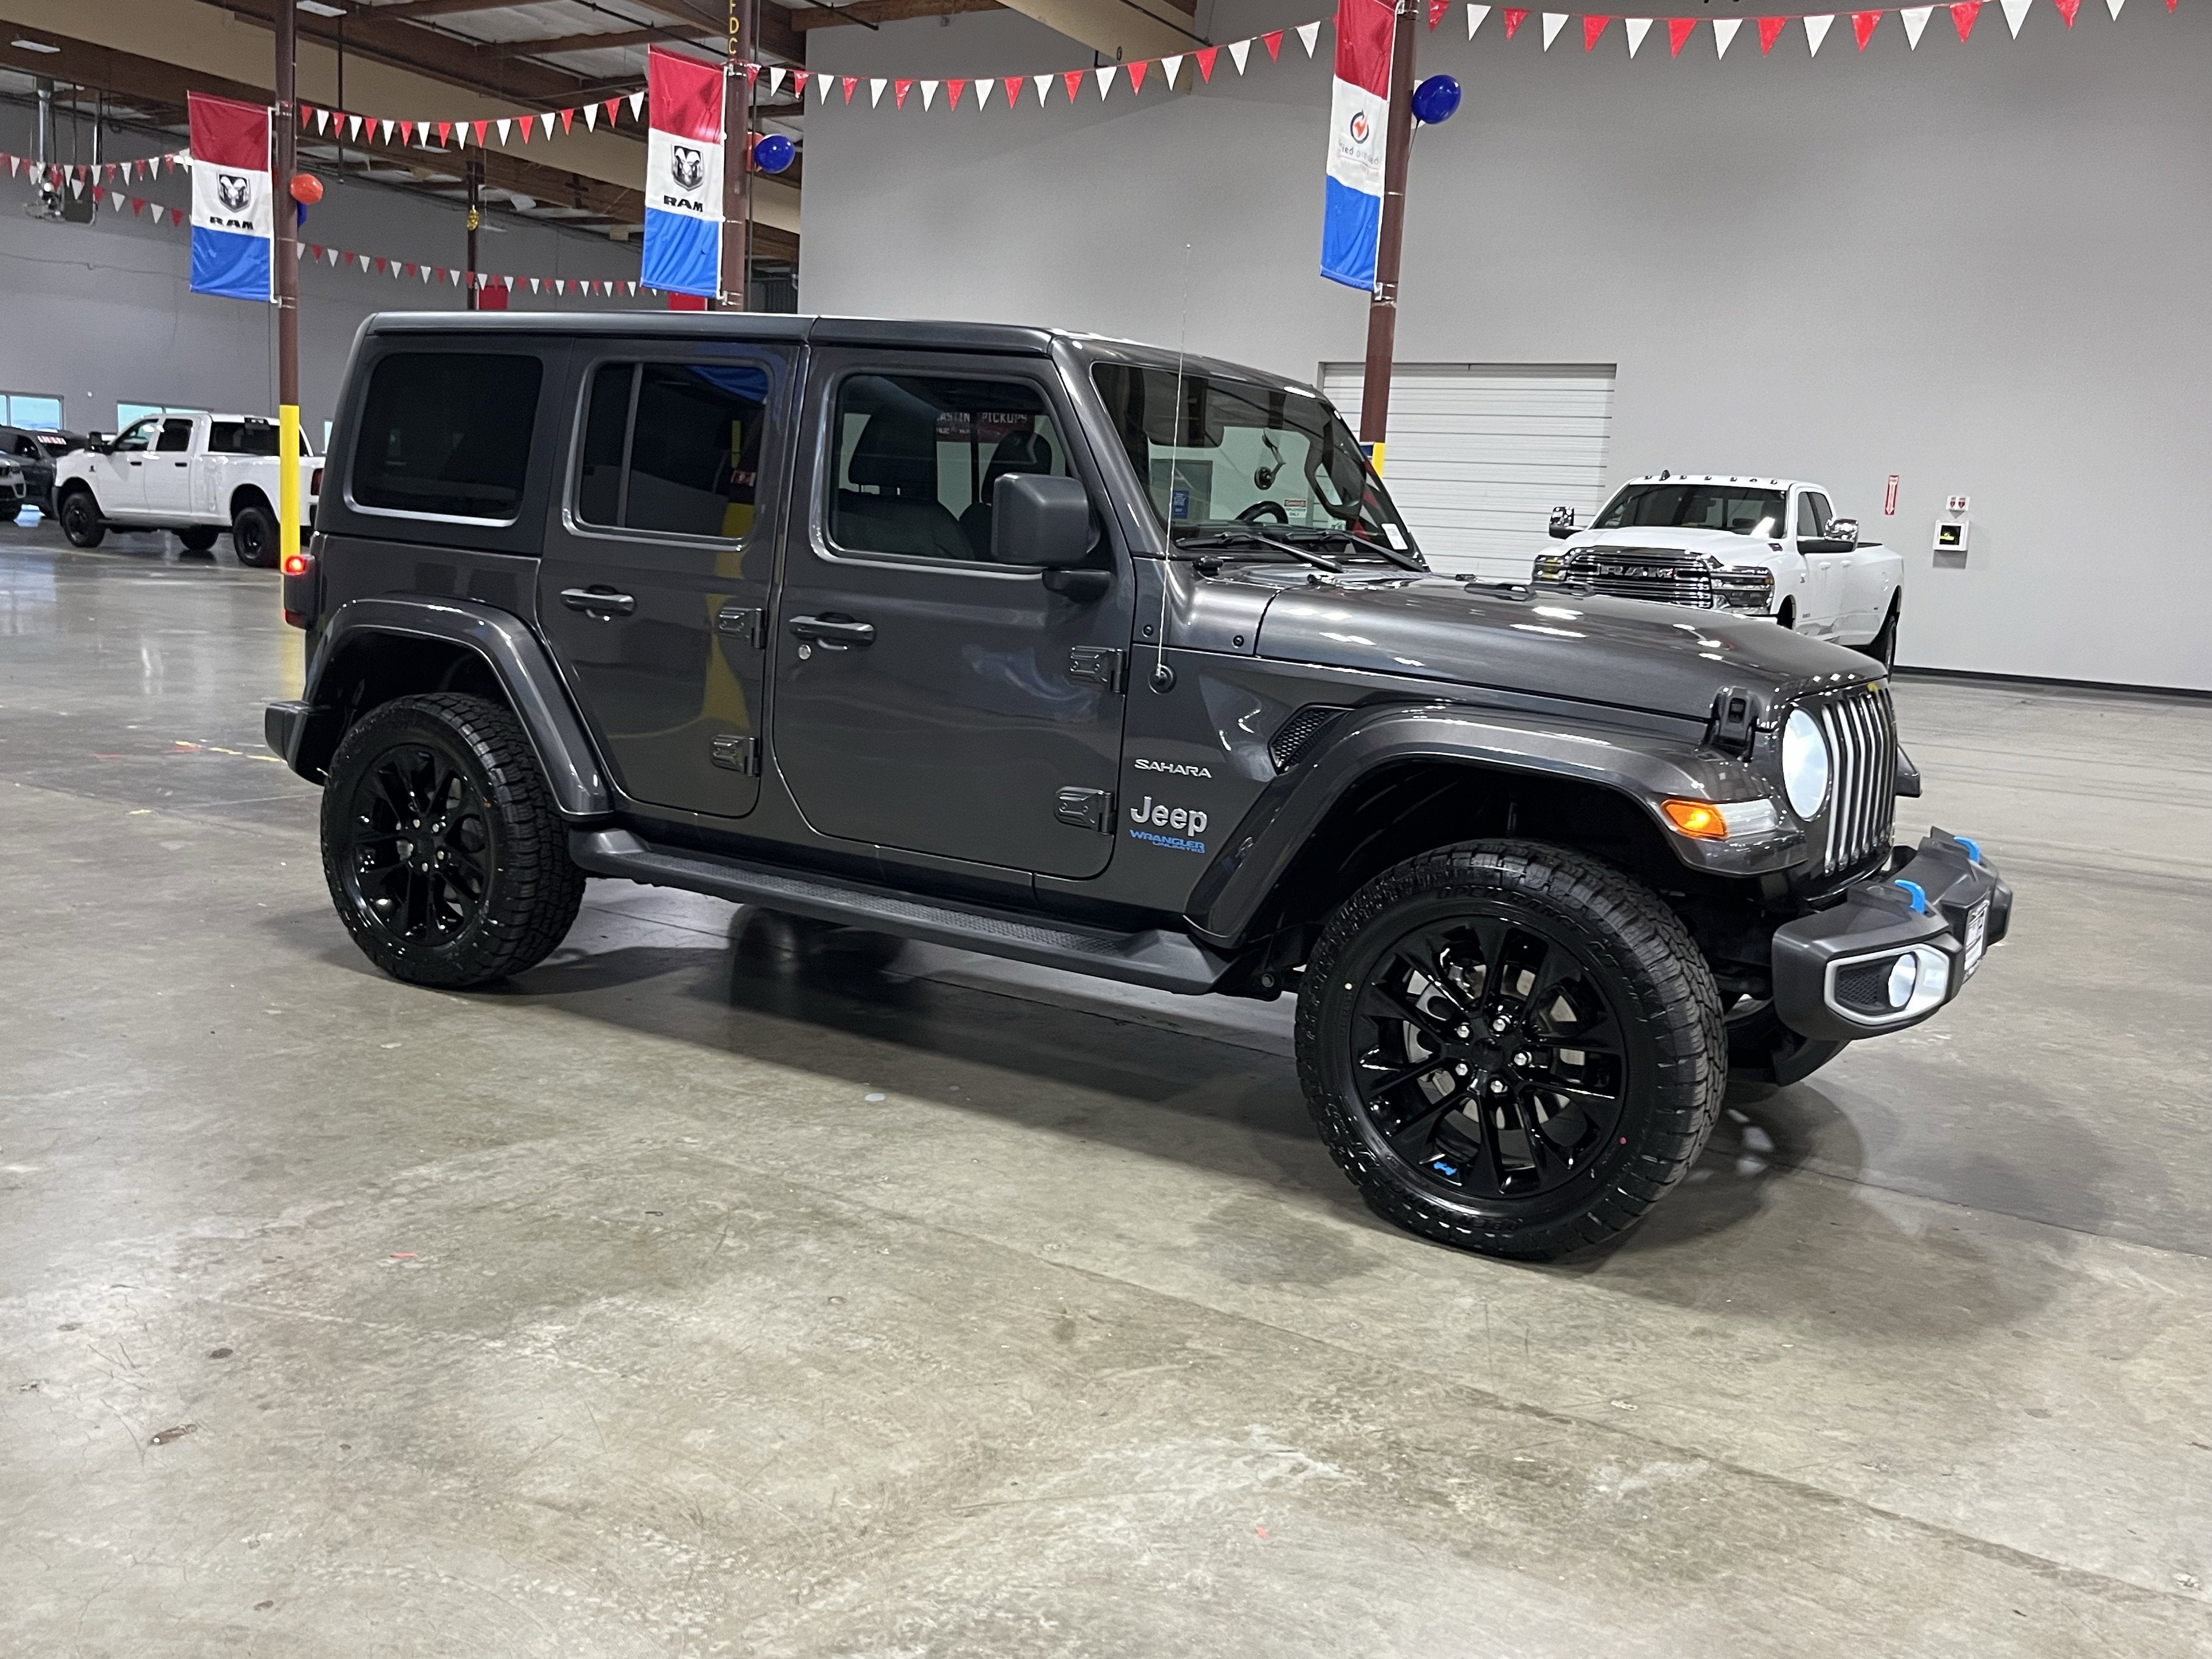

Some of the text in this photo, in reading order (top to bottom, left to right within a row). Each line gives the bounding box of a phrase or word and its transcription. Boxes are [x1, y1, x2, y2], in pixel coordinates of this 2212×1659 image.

[664, 195, 703, 212] RAM
[210, 216, 253, 230] RAM
[1600, 566, 1673, 578] RAM
[1135, 759, 1212, 778] SAHARA
[1130, 795, 1207, 837] Jeep
[1130, 829, 1205, 849] WRANGLER
